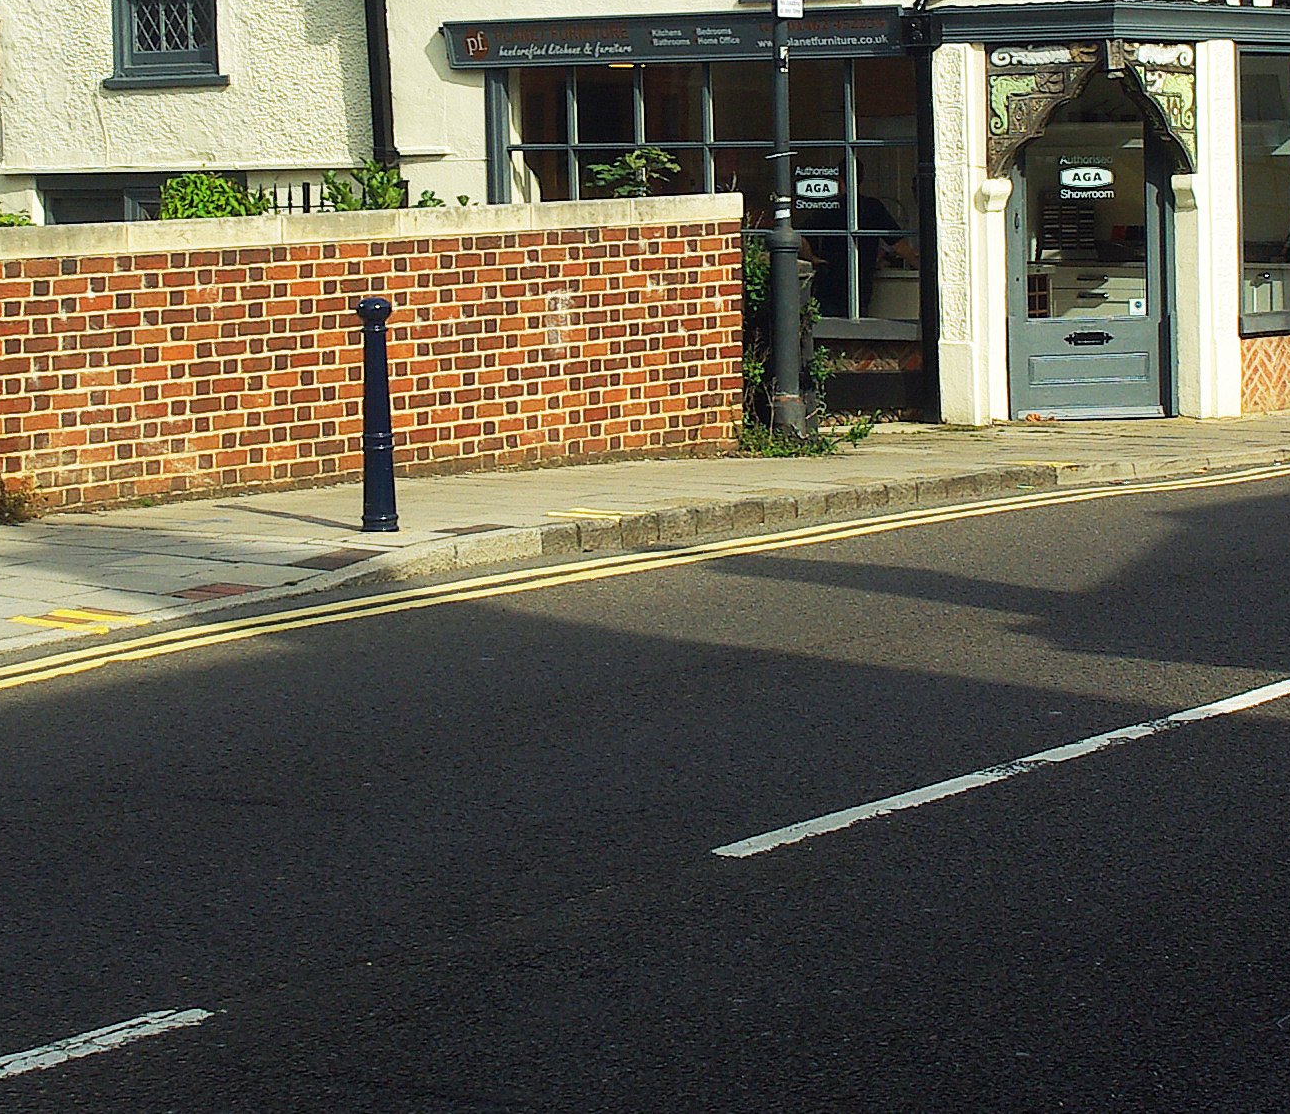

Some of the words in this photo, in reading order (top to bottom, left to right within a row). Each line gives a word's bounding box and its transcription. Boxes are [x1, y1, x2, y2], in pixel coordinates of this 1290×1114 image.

[550, 21, 629, 40] FURNITURE
[695, 27, 732, 36] Bedrooms
[652, 38, 690, 46] Bathrooms
[697, 37, 718, 45] Home
[719, 36, 740, 44] Office
[499, 43, 547, 59] handcrafted
[548, 43, 581, 55] kitchens
[584, 43, 592, 54] &
[593, 41, 632, 57] furniture
[1060, 155, 1113, 164] Authorised
[795, 166, 839, 176] Authorised
[1072, 172, 1102, 182] AGA
[805, 183, 830, 193] AGA
[1060, 189, 1114, 199] Showroom
[795, 199, 840, 209] Showroom
